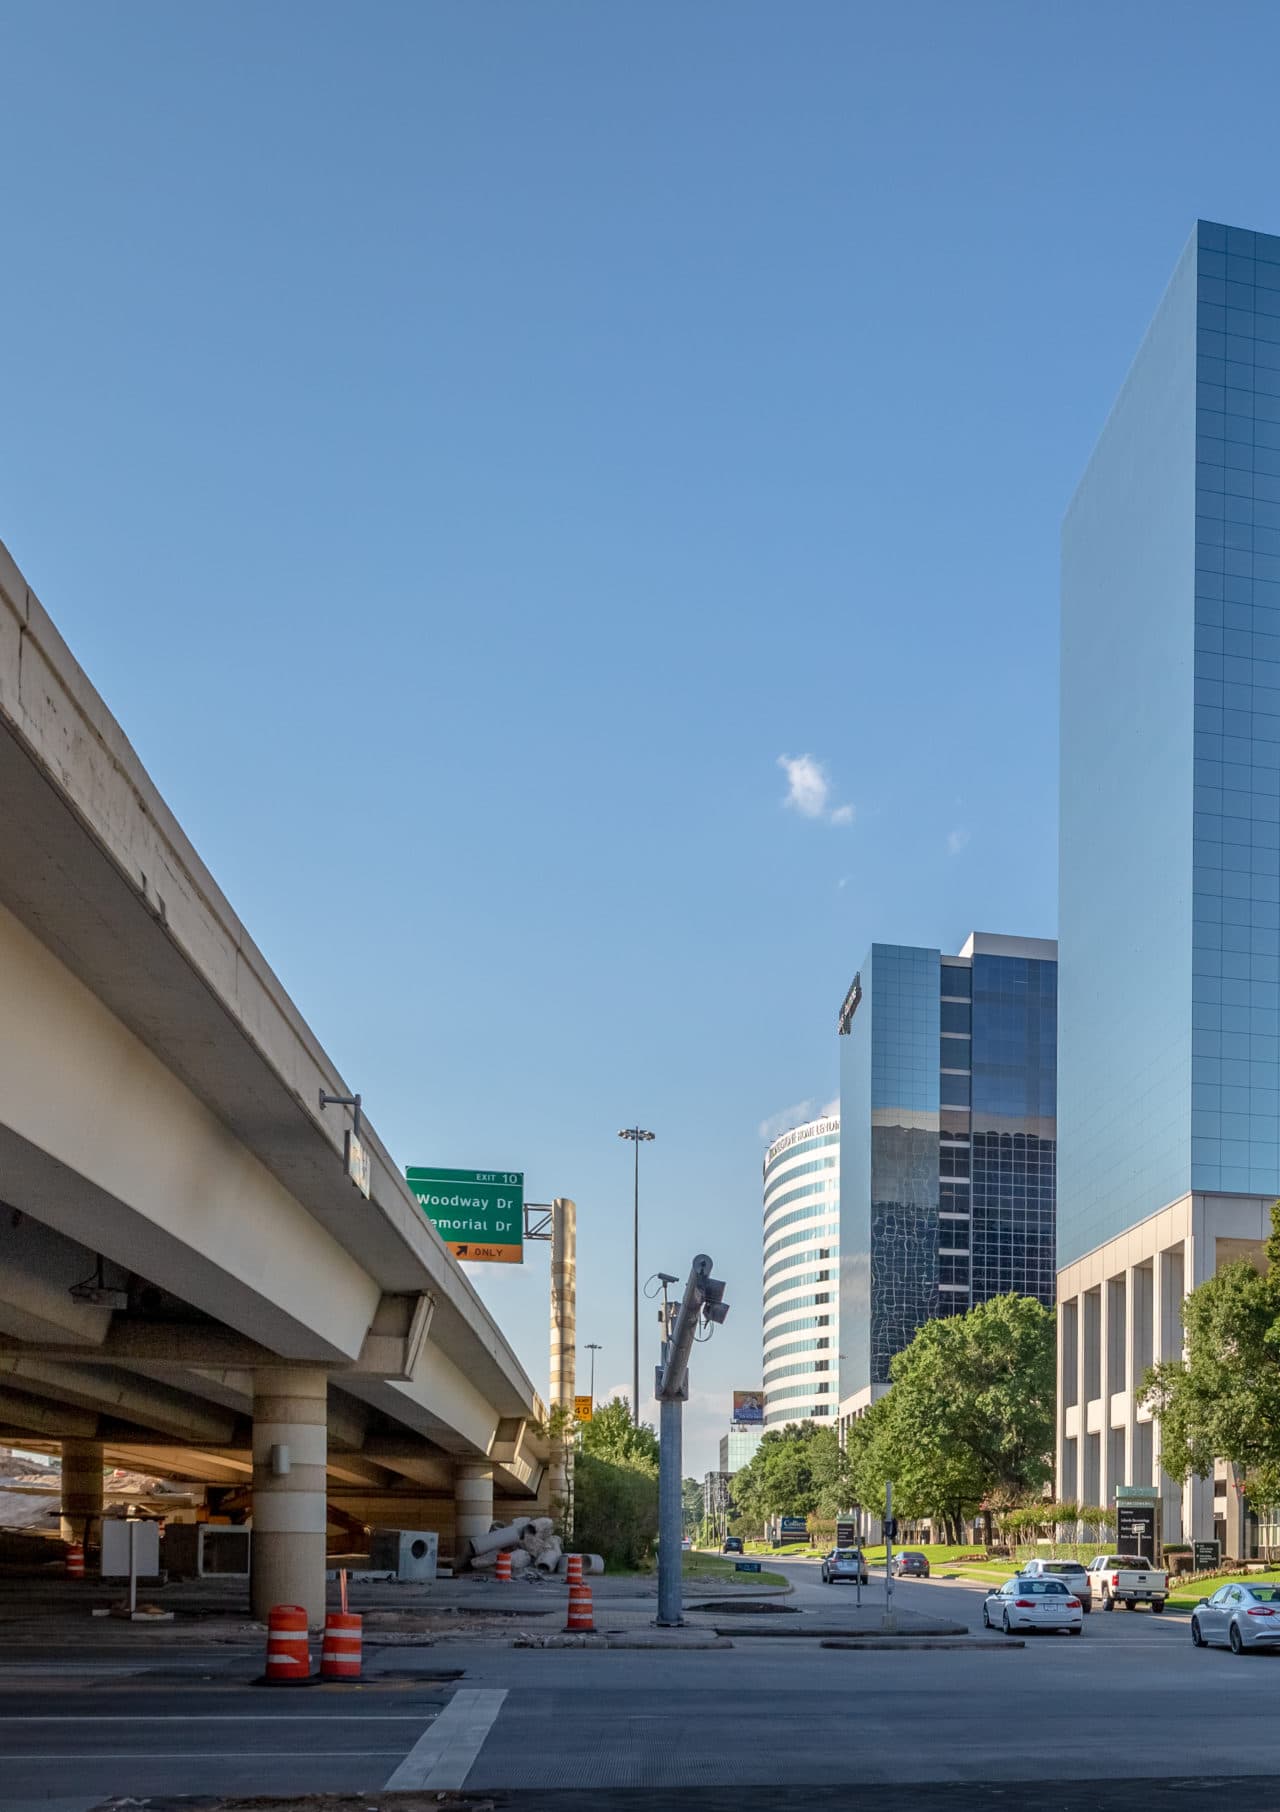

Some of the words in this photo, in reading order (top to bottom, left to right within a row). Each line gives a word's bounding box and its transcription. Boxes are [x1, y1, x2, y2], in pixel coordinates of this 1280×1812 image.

[476, 1173, 497, 1182] EXIT
[502, 1174, 517, 1184] 10
[416, 1193, 489, 1210] Woodway
[497, 1198, 514, 1209] Dr
[430, 1218, 488, 1231] emorial
[495, 1221, 512, 1231] Dr
[474, 1248, 503, 1257] ONLY
